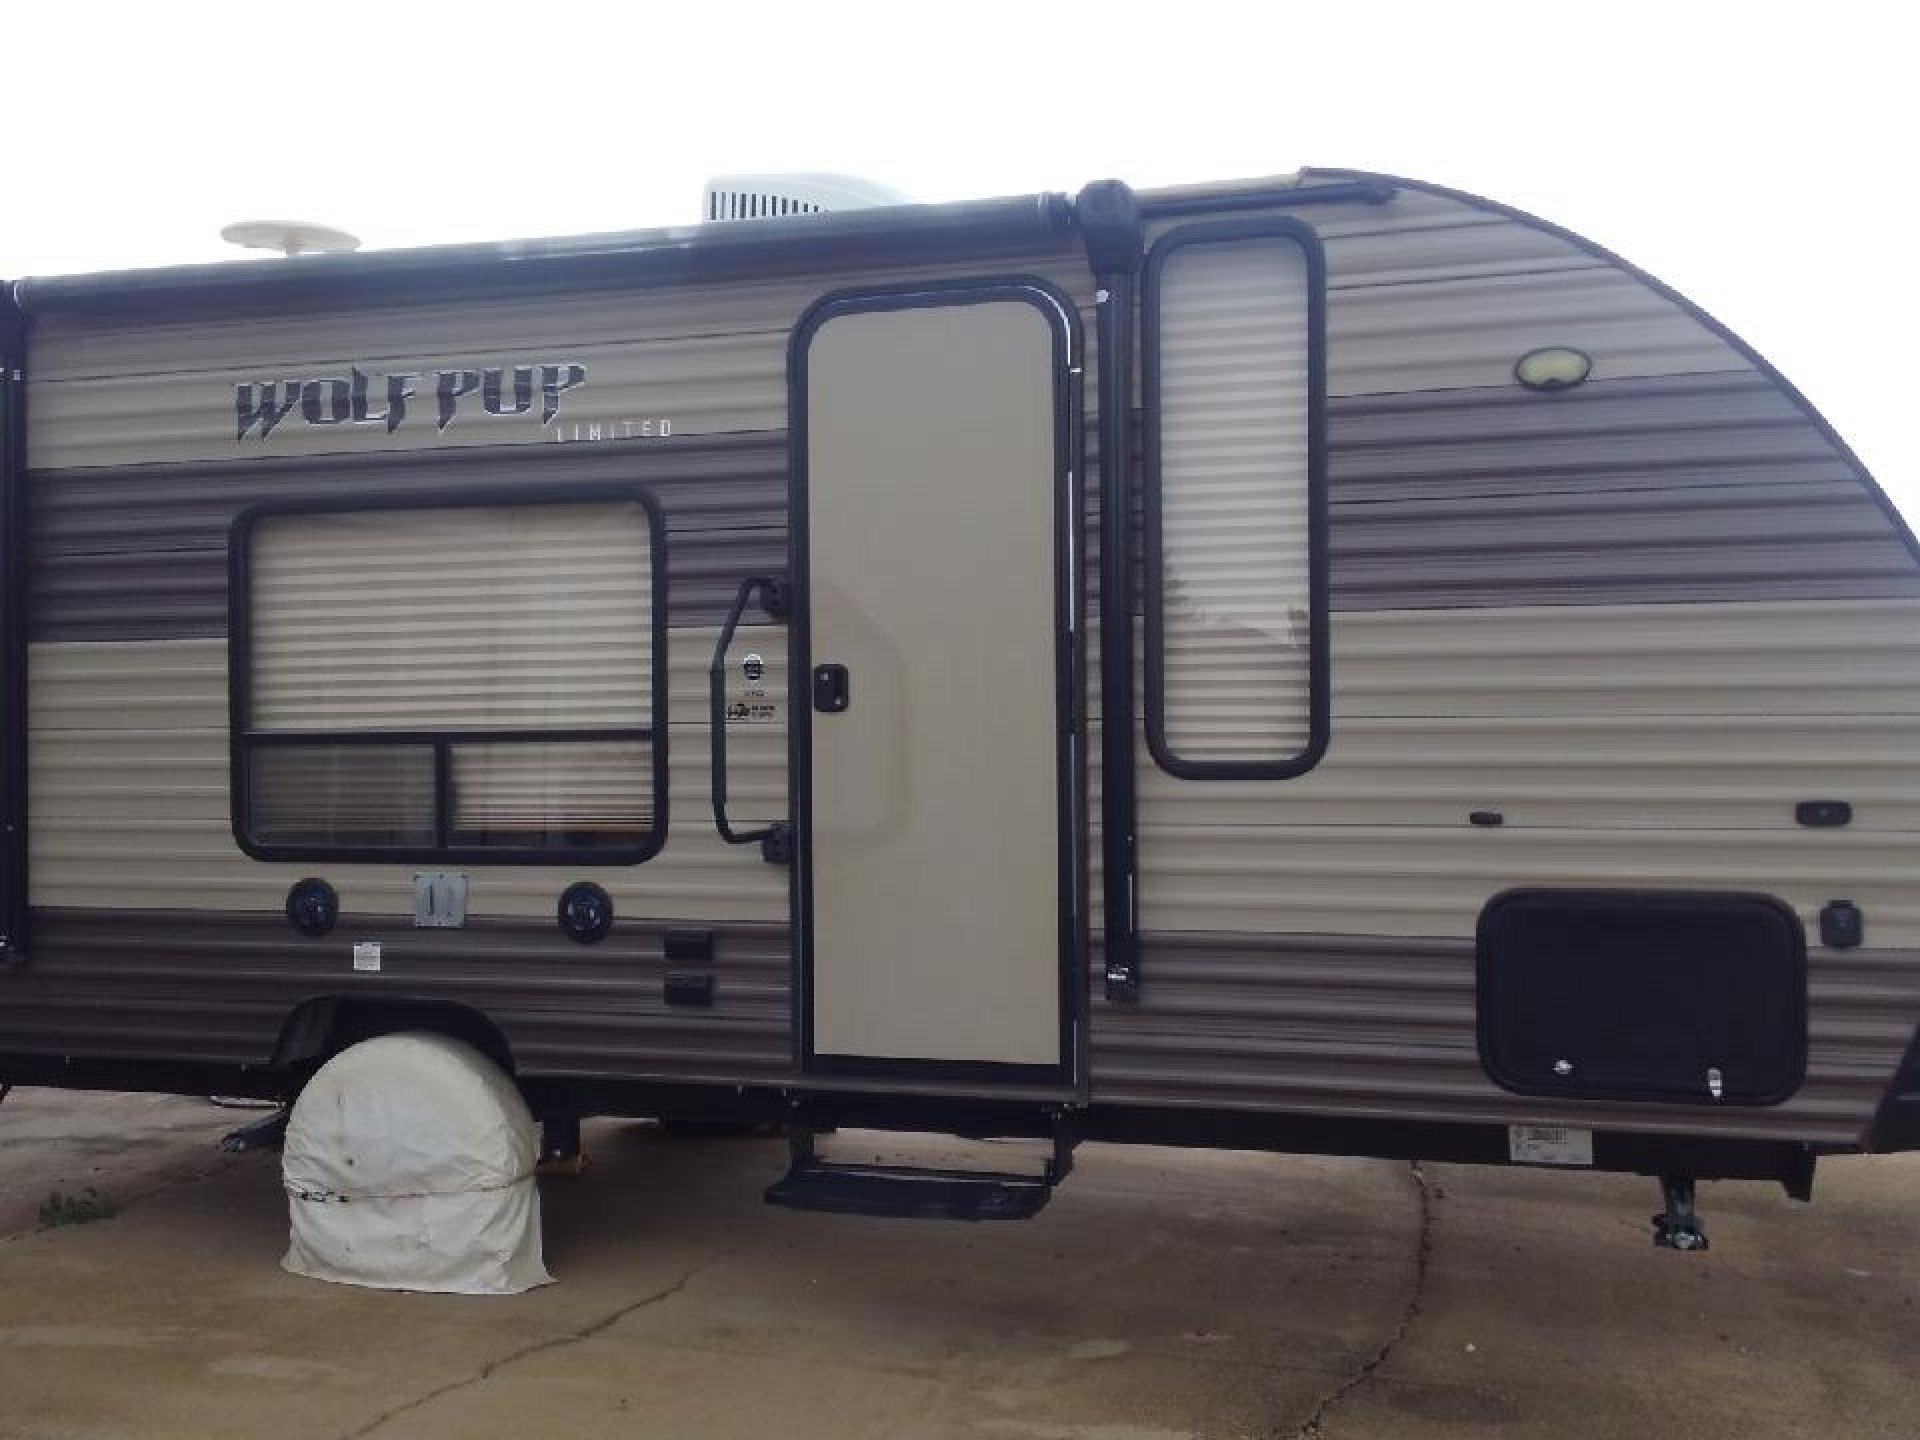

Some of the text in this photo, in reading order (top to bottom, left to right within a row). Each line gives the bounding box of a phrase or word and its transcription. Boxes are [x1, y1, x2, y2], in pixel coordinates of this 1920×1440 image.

[234, 362, 587, 443] WOLF PUP
[557, 419, 672, 442] LIMITED
